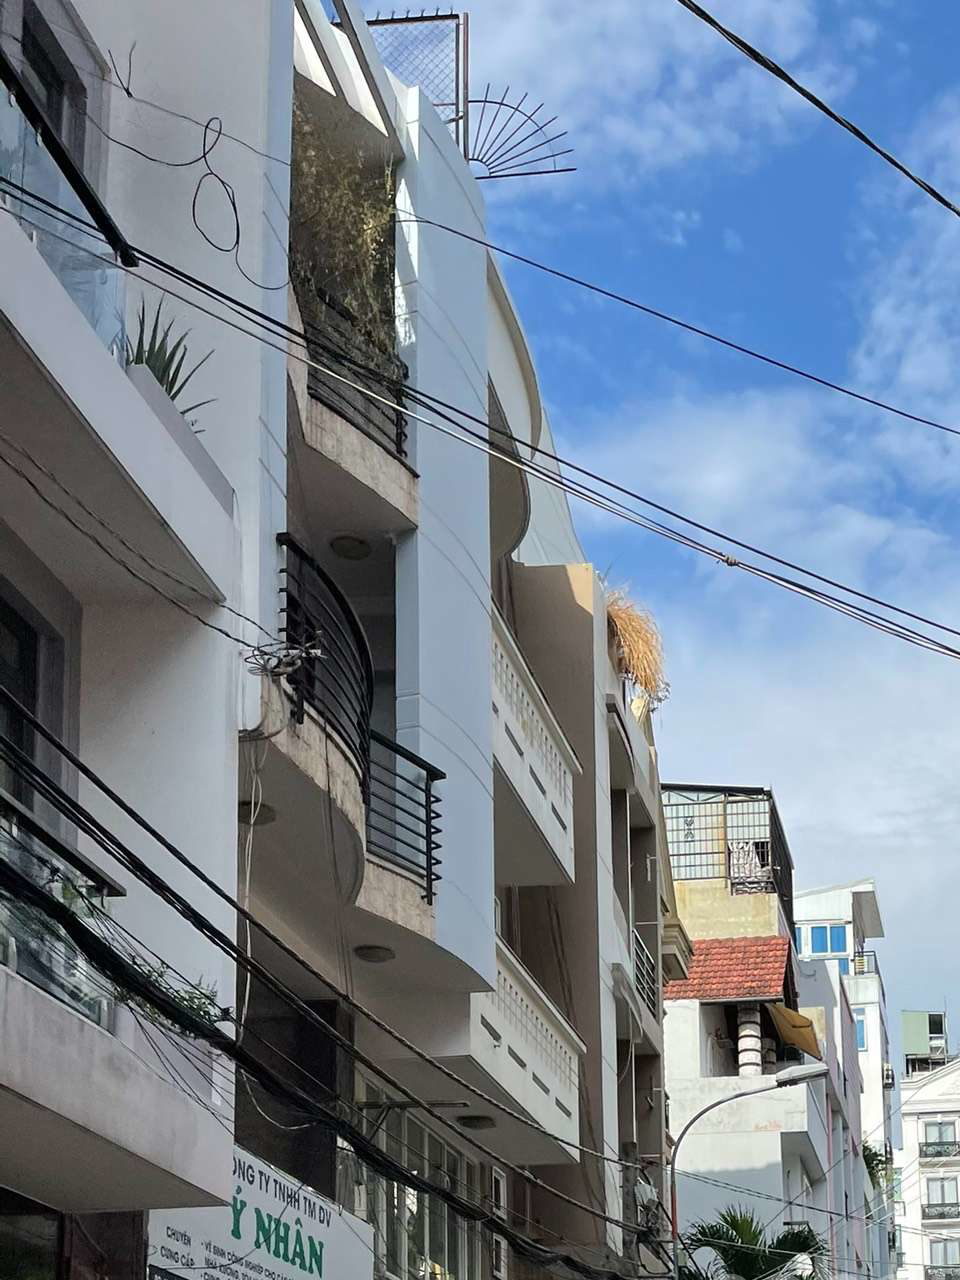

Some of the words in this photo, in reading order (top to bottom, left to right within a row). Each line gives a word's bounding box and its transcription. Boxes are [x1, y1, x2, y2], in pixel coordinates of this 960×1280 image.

[258, 1169, 270, 1194] TY
[273, 1178, 301, 1211] TNHH
[303, 1196, 317, 1220] TM
[319, 1205, 332, 1228] DV
[254, 1207, 324, 1279] NHÂN
